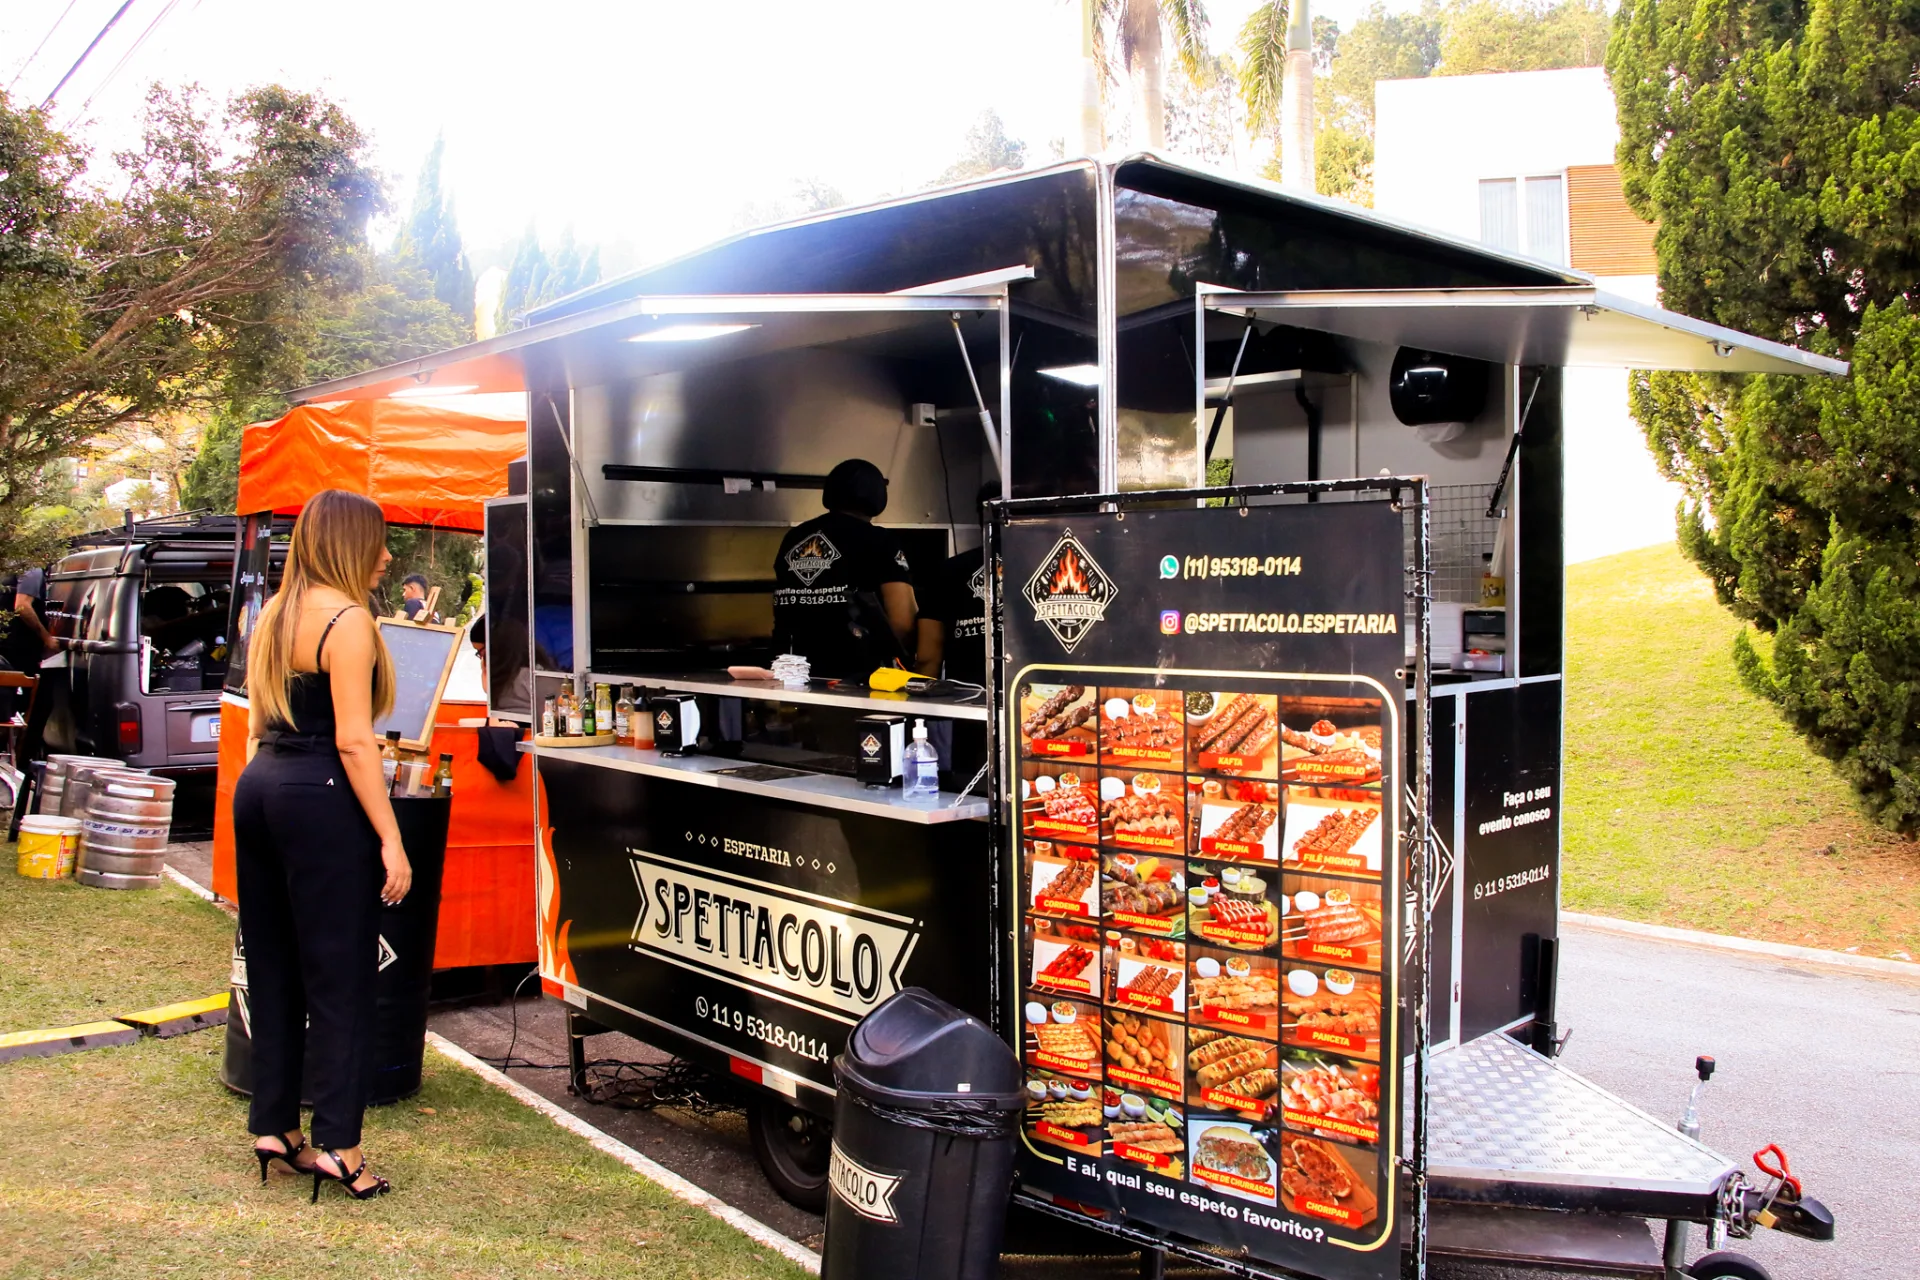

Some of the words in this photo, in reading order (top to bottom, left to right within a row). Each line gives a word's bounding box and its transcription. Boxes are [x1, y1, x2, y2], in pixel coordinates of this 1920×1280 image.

[1184, 555, 1208, 580] (11)
[1210, 556, 1301, 577] 95318-0114
[790, 596, 797, 605] 9
[800, 595, 848, 605] 5318-011
[1041, 604, 1096, 616] SPETTACOLO
[1184, 613, 1397, 634] @SPETTACOLO.ESPETARIA
[1047, 743, 1070, 753] CARNE
[1113, 747, 1137, 757] CARNE
[1138, 748, 1147, 758] C/
[1148, 750, 1171, 760] BACON
[1218, 756, 1243, 767] KAFTA
[1296, 762, 1322, 773] KAFTA
[1323, 763, 1333, 774] C/
[1333, 765, 1365, 776] QUEIJO
[1503, 791, 1525, 809] Faça
[1526, 790, 1533, 802] o
[1534, 786, 1551, 801] seu
[1067, 825, 1087, 834] FRANGO
[1479, 815, 1512, 835] evento
[1513, 807, 1551, 827] conosco
[1116, 833, 1145, 844] MEDALHÃO
[1146, 837, 1154, 845] DE
[1155, 837, 1174, 847] CARNE
[1215, 842, 1249, 854] PICANHA
[723, 838, 792, 867] ESPETARIA
[1303, 853, 1323, 864] FILÉ
[1324, 856, 1361, 867] MIGNON
[1484, 880, 1497, 897] 11
[1498, 877, 1505, 893] 9
[1505, 864, 1550, 890] 5318-0114
[1043, 900, 1080, 912] CORDEIRO
[1114, 912, 1145, 925] YAKITORI
[1145, 917, 1173, 930] BOVINO
[655, 878, 883, 1004] SPETTACOLO
[1203, 925, 1235, 938] SALSICHÃO
[1235, 930, 1242, 939] C/
[1242, 931, 1265, 942] QUEIJO
[1313, 944, 1352, 958] LINGUIÇA
[1128, 992, 1162, 1006] CORAÇÃO
[1218, 1011, 1249, 1024] FRANGO
[712, 1003, 731, 1028] 11
[733, 1011, 743, 1032] 9
[746, 1016, 829, 1064] 5318-0114
[1312, 1031, 1350, 1046] PANCETA
[1037, 1051, 1059, 1065] QUEIJO
[1059, 1057, 1088, 1070] COALHO
[1108, 1067, 1145, 1083] MUSSARELA
[1146, 1077, 1181, 1092] DEFUMADA
[1208, 1091, 1224, 1102] PÃO
[1225, 1095, 1234, 1104] DE
[1235, 1098, 1256, 1110] ALHO
[1284, 1111, 1322, 1127] MEDALHÃO
[1323, 1119, 1332, 1129] DE
[1332, 1121, 1376, 1138] PROVOLONE
[1047, 1126, 1075, 1141] PINTADO
[1126, 1149, 1155, 1163] SALMÃO
[830, 1149, 877, 1207] TTACOLO
[1193, 1167, 1219, 1181] LANCHE
[1220, 1174, 1230, 1184] DE
[1230, 1177, 1274, 1195] CHURRASCO
[1067, 1156, 1077, 1173] E
[1081, 1162, 1101, 1182] aí,
[1106, 1169, 1141, 1190] qual
[1146, 1180, 1175, 1200] seu
[1179, 1191, 1238, 1219] espeto
[1243, 1209, 1324, 1244] favorito?
[1306, 1201, 1349, 1219] CHORIPAN
